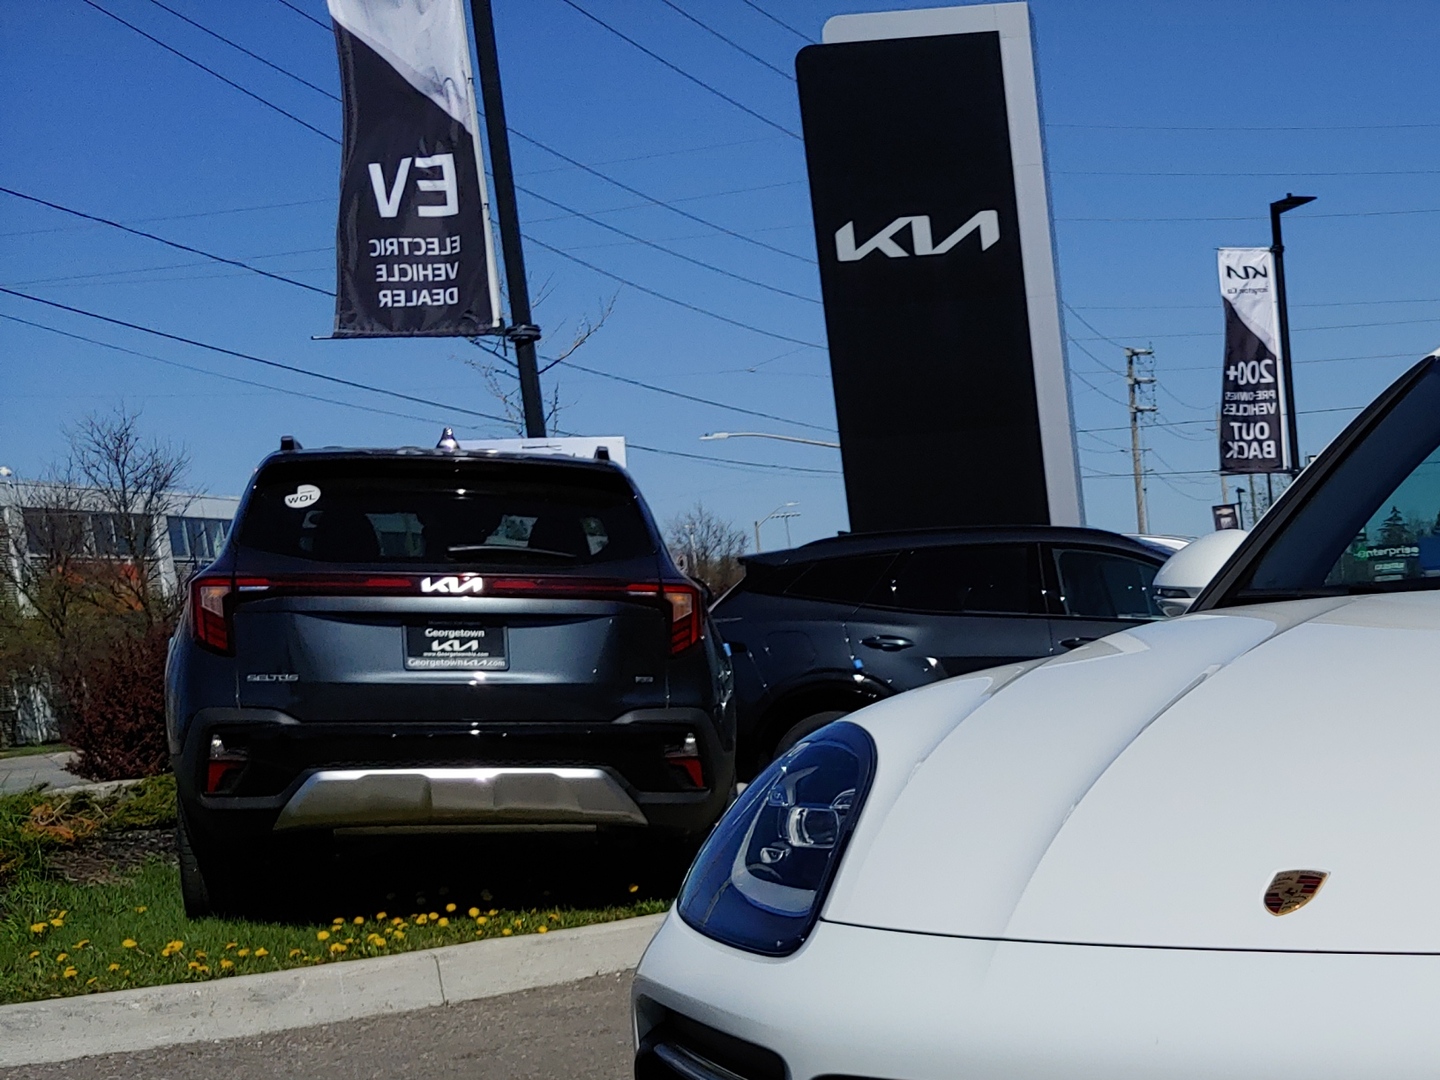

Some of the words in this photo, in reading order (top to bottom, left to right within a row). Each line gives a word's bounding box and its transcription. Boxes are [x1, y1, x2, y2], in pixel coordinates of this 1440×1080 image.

[835, 209, 1000, 262] KIA
[1357, 545, 1420, 558] enterprise
[421, 576, 483, 593] KIA
[425, 628, 485, 638] Georgetown
[431, 639, 479, 651] KIA
